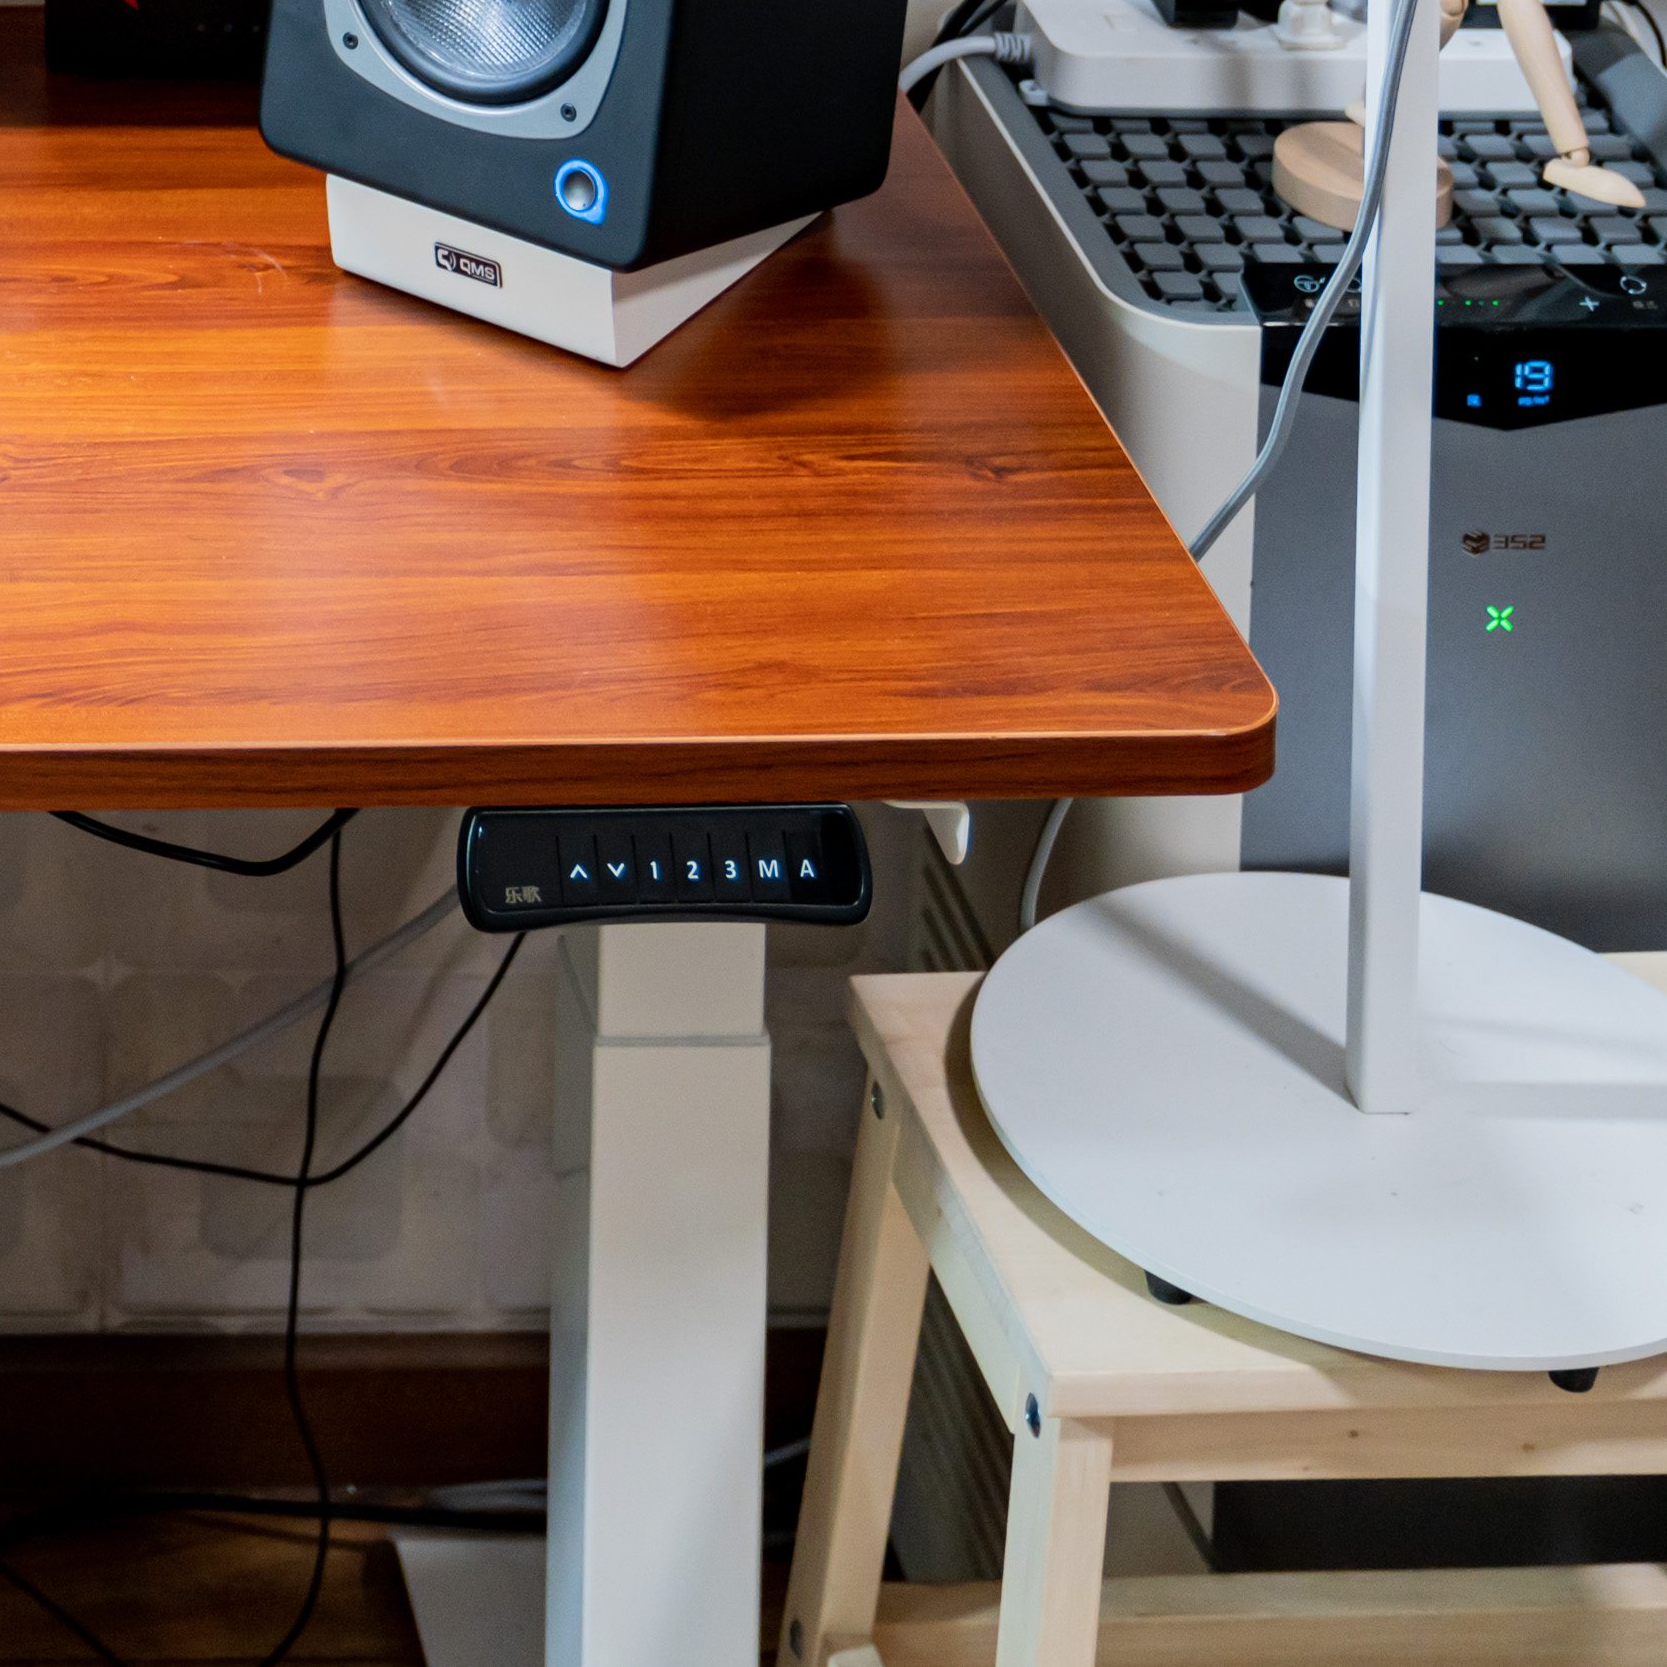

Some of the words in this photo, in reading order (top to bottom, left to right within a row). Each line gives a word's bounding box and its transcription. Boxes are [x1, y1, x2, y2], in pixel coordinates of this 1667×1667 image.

[459, 257, 496, 281] QMS
[1514, 360, 1552, 391] 19
[1492, 534, 1546, 550] 352
[649, 861, 659, 881] 1
[686, 860, 700, 880] 2
[724, 859, 738, 879] 3
[758, 859, 781, 879] M
[799, 859, 815, 879] A
[505, 885, 543, 904] 乐歌
